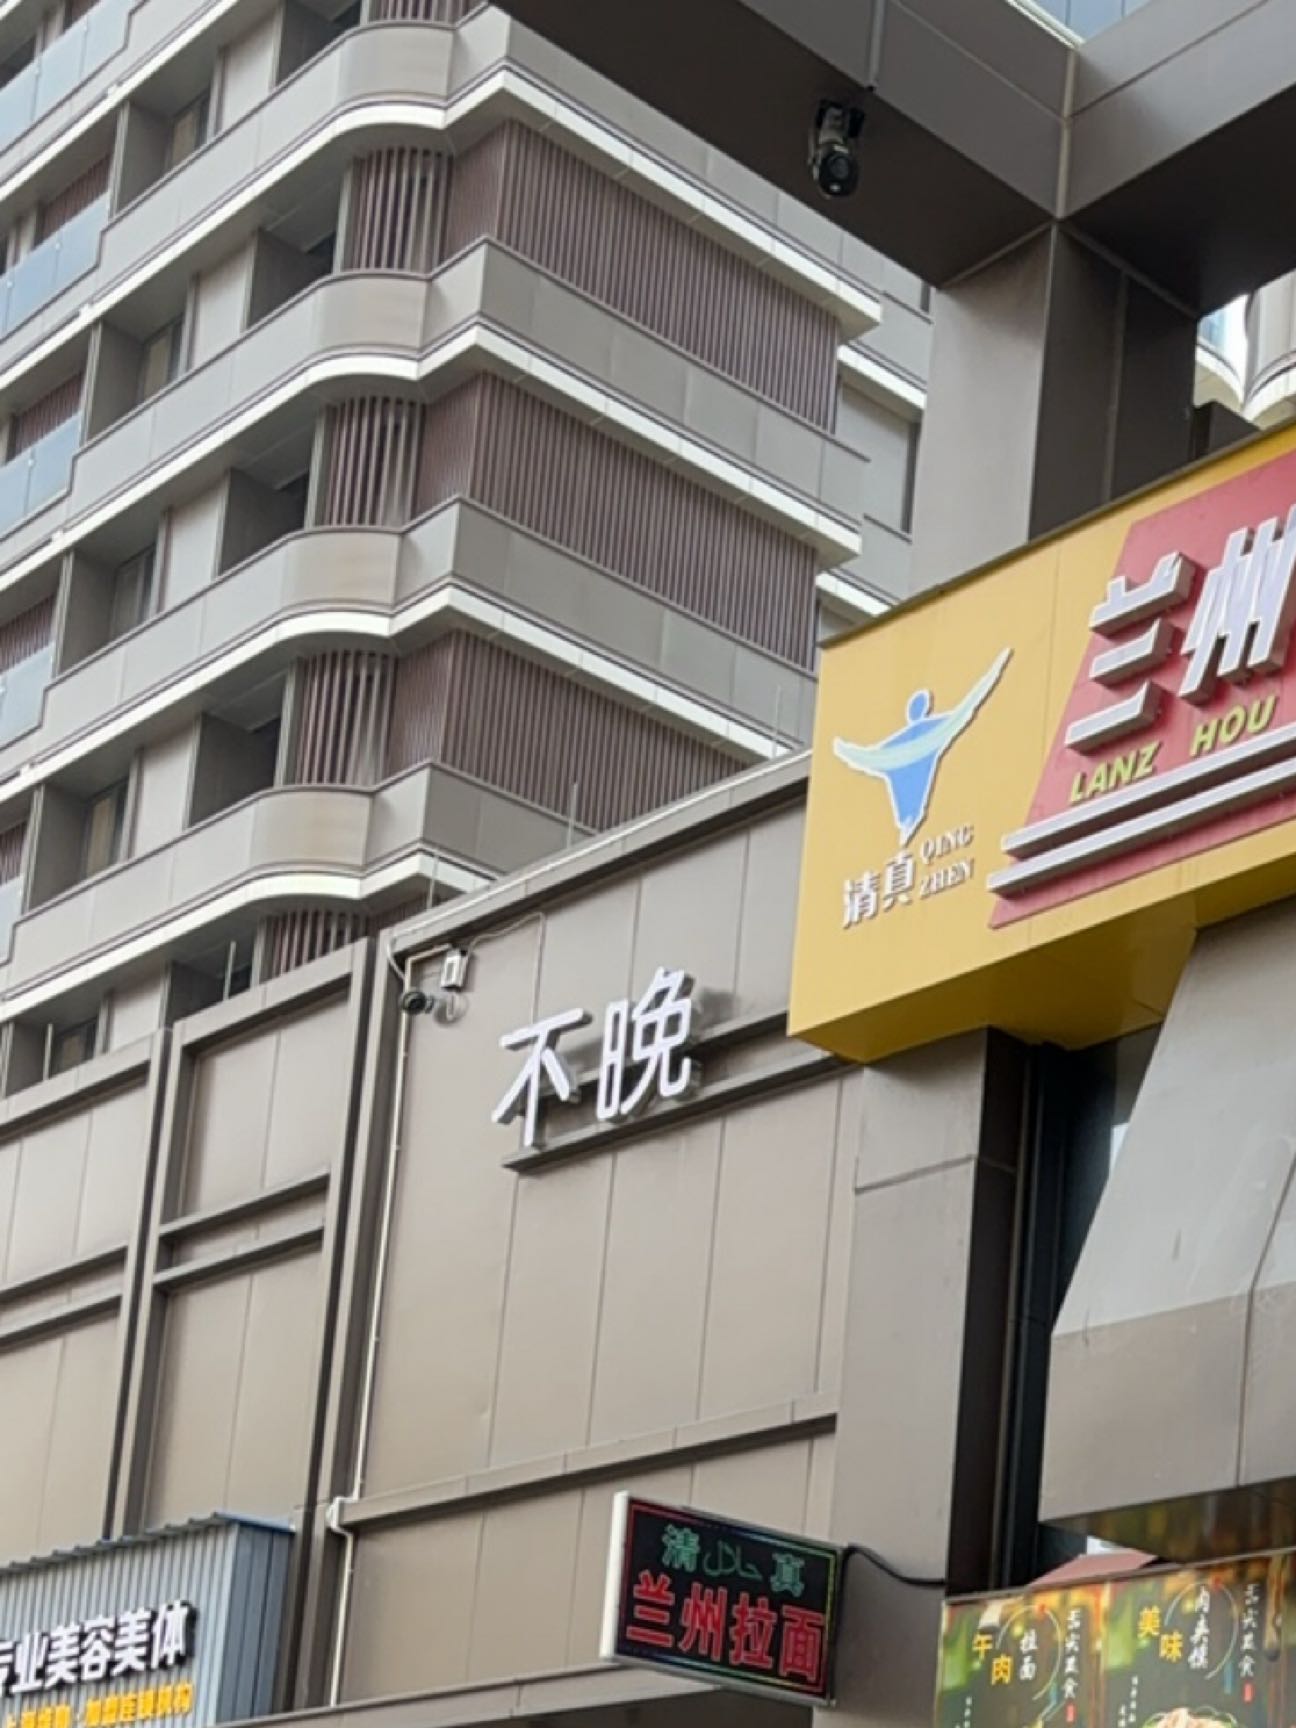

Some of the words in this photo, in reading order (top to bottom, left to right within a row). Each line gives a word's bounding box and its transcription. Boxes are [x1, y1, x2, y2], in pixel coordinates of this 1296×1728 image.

[1068, 740, 1163, 802] LANZ
[1190, 696, 1278, 757] HOU
[842, 849, 915, 928] 清真
[919, 859, 974, 900] ZHEN
[921, 824, 974, 862] QING
[492, 966, 693, 1147] 不晚
[626, 1569, 825, 1682] 兰州拉面
